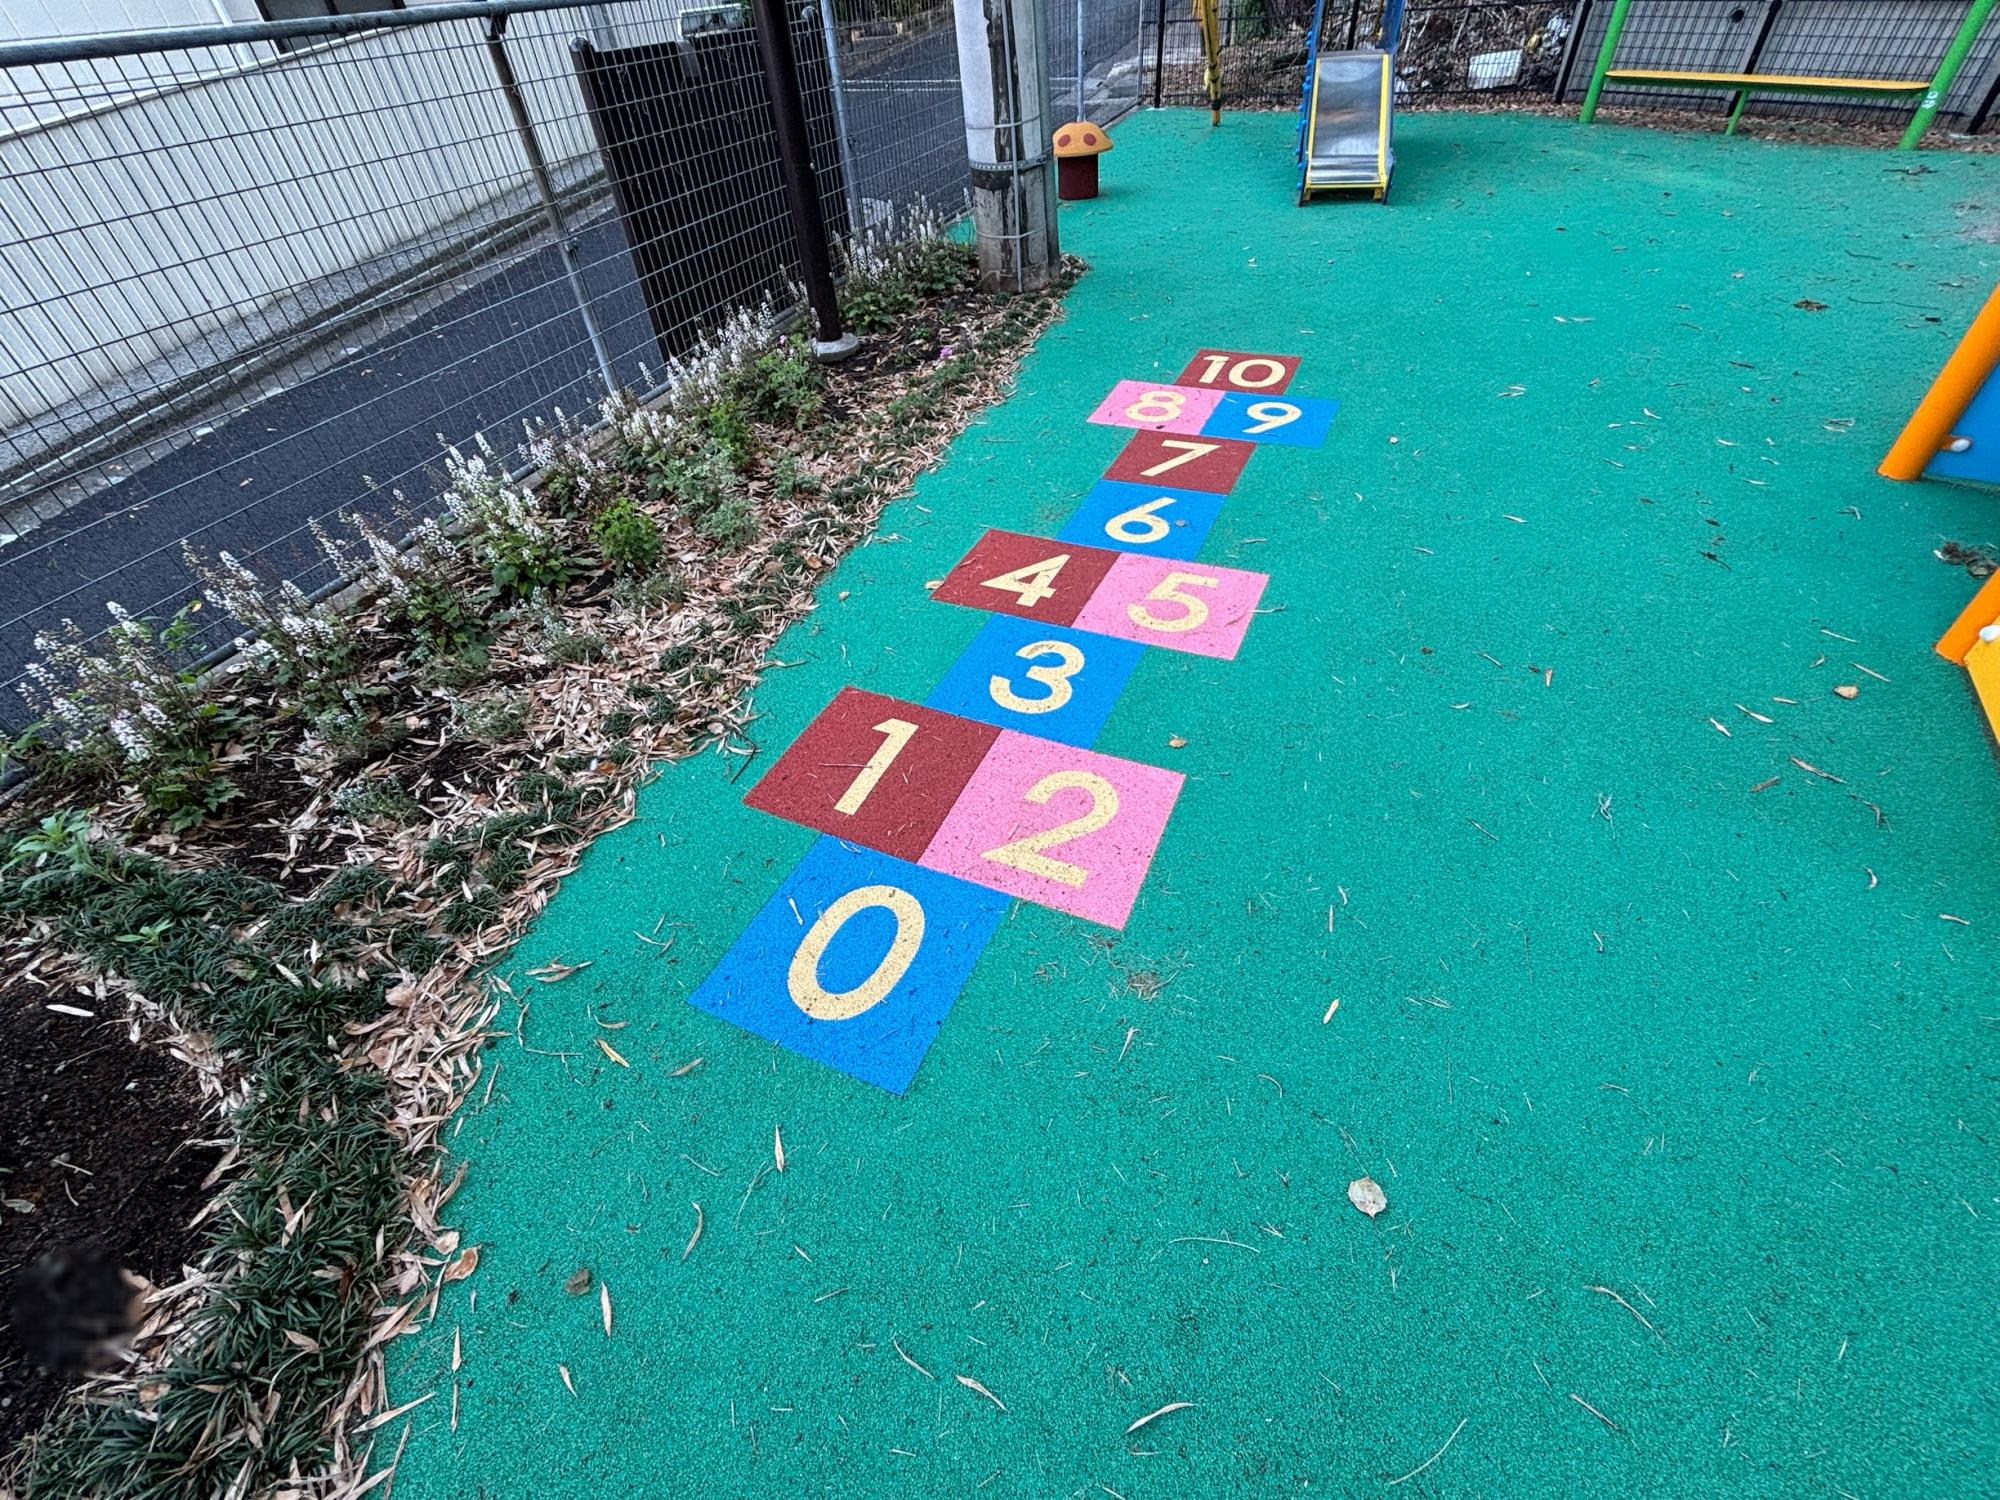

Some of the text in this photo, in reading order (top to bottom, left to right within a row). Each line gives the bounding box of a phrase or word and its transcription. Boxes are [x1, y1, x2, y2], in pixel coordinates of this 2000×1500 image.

[1199, 355, 1286, 388] 10
[1124, 390, 1186, 422] 8
[1242, 401, 1302, 433] 9
[1139, 439, 1222, 477] 7
[1105, 497, 1177, 543] 6
[980, 554, 1070, 607] 4
[1127, 571, 1220, 632] 5
[989, 640, 1085, 714] 3
[833, 718, 919, 815] 1
[980, 770, 1119, 888] 2
[787, 885, 925, 1020] 0
